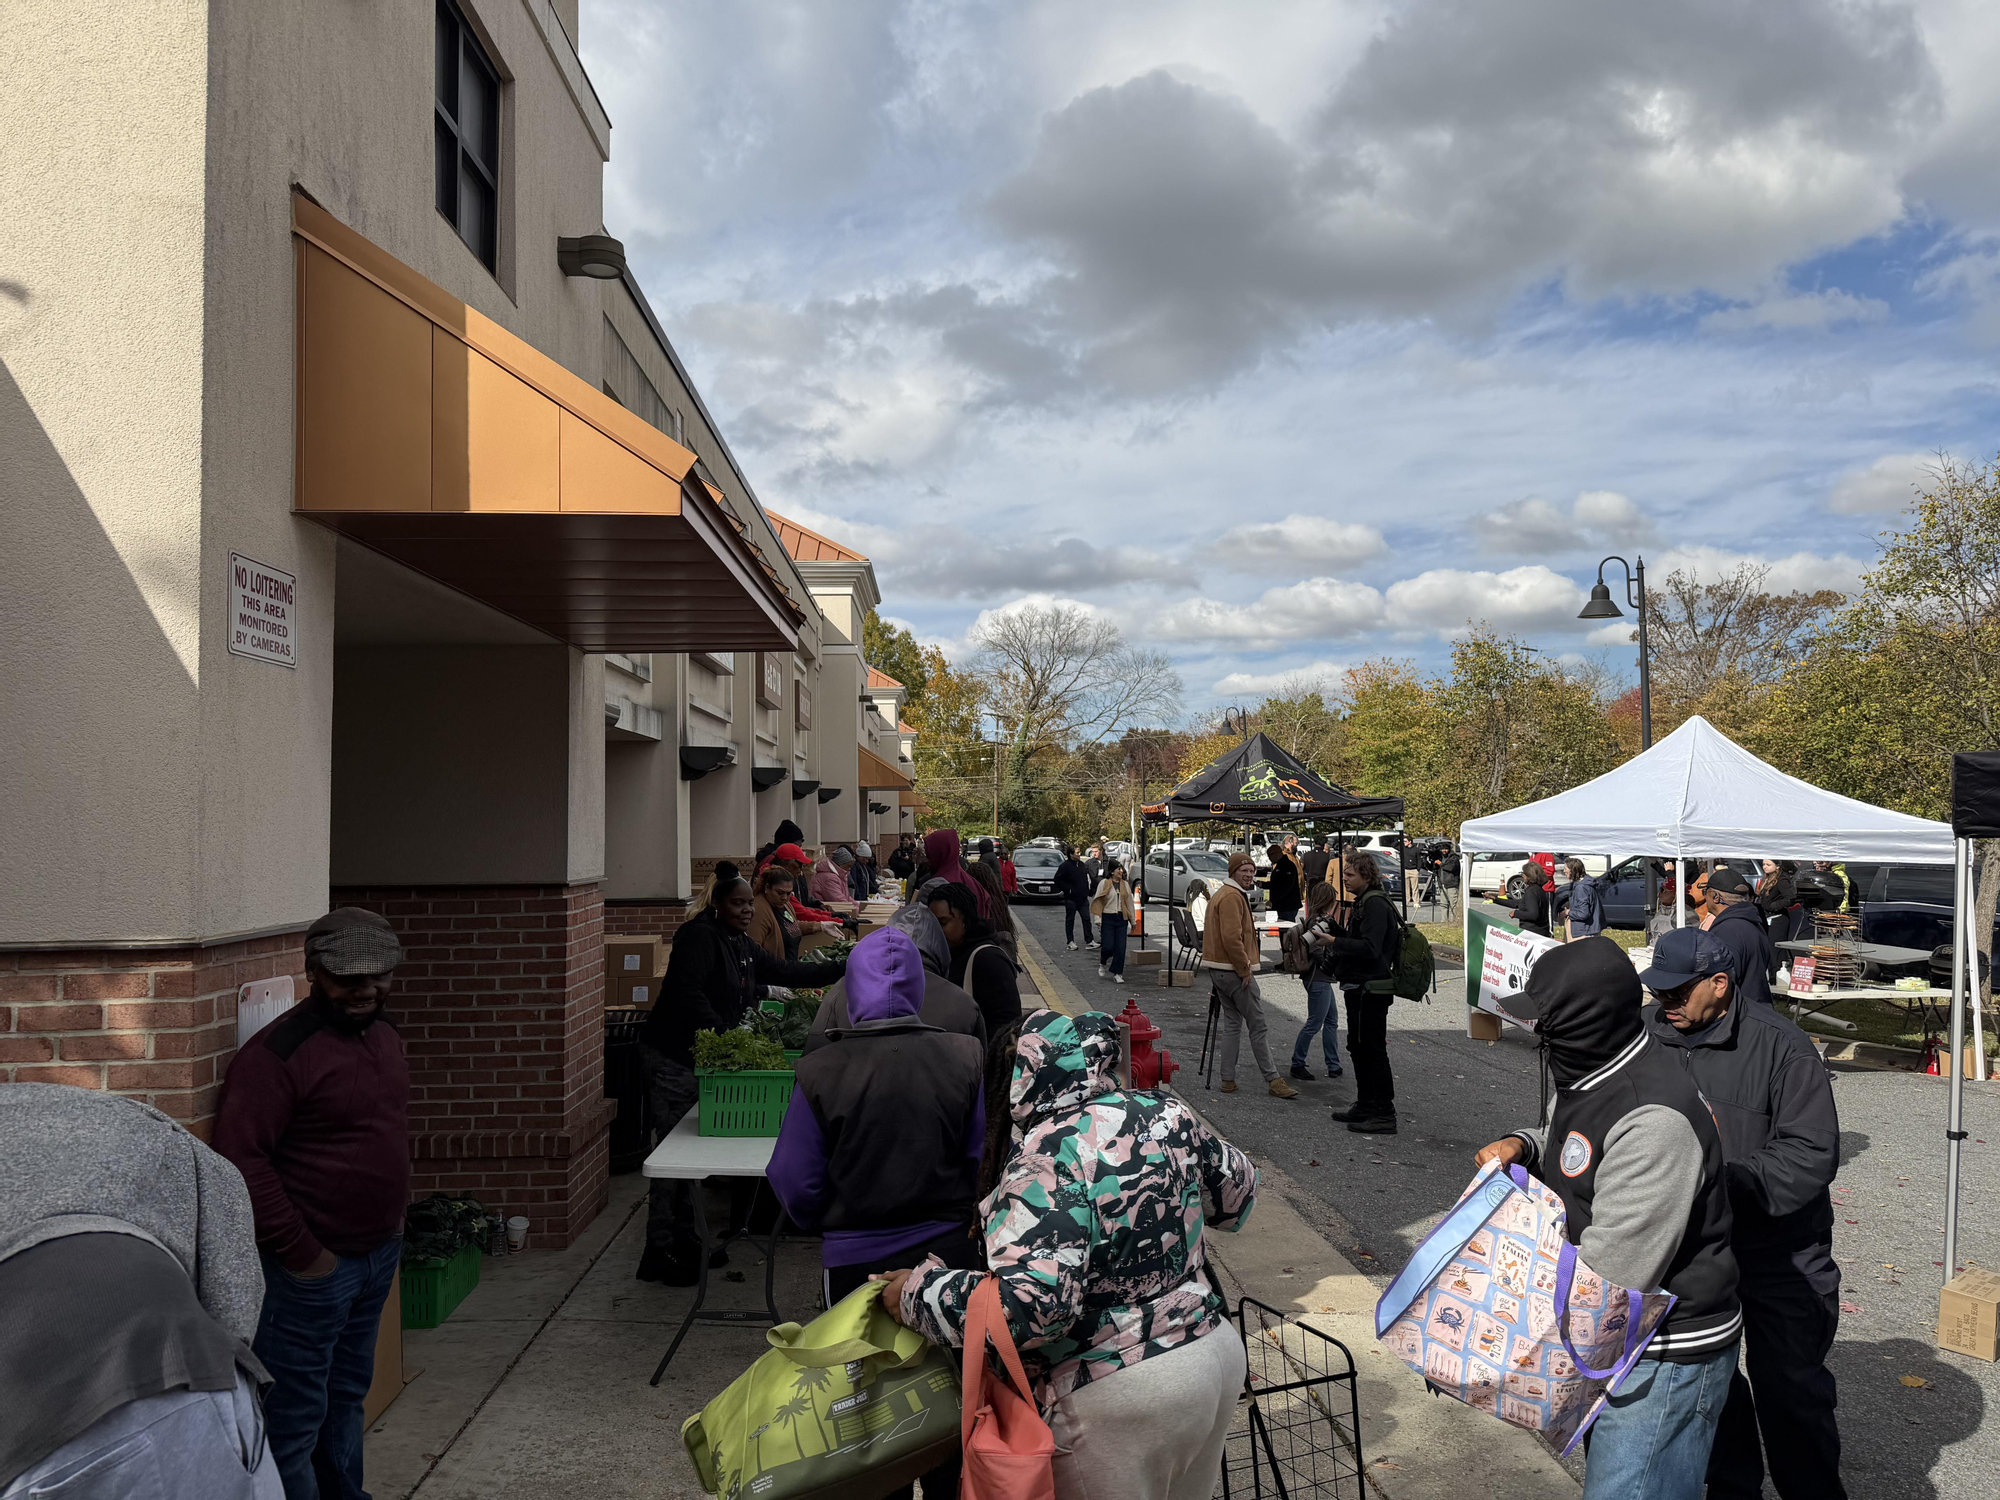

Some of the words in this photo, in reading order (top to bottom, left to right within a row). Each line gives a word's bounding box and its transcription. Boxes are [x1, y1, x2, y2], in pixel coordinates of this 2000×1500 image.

[235, 565, 247, 589] NO
[250, 570, 293, 605] LOITERING
[242, 594, 261, 612] THIS
[264, 602, 286, 620] AREA
[239, 612, 288, 638] MONITORED
[236, 630, 247, 645] BY
[251, 635, 290, 657] CAMERAS
[1240, 791, 1277, 801] FOOD
[1490, 928, 1514, 942] Authentic
[1514, 938, 1528, 947] brick
[1502, 1244, 1528, 1262] ITALIAN
[1492, 1325, 1505, 1358] DOLCI
[1518, 1340, 1538, 1354] BAO
[833, 1398, 856, 1411] TRADER
[856, 1392, 867, 1403] JOE'S
